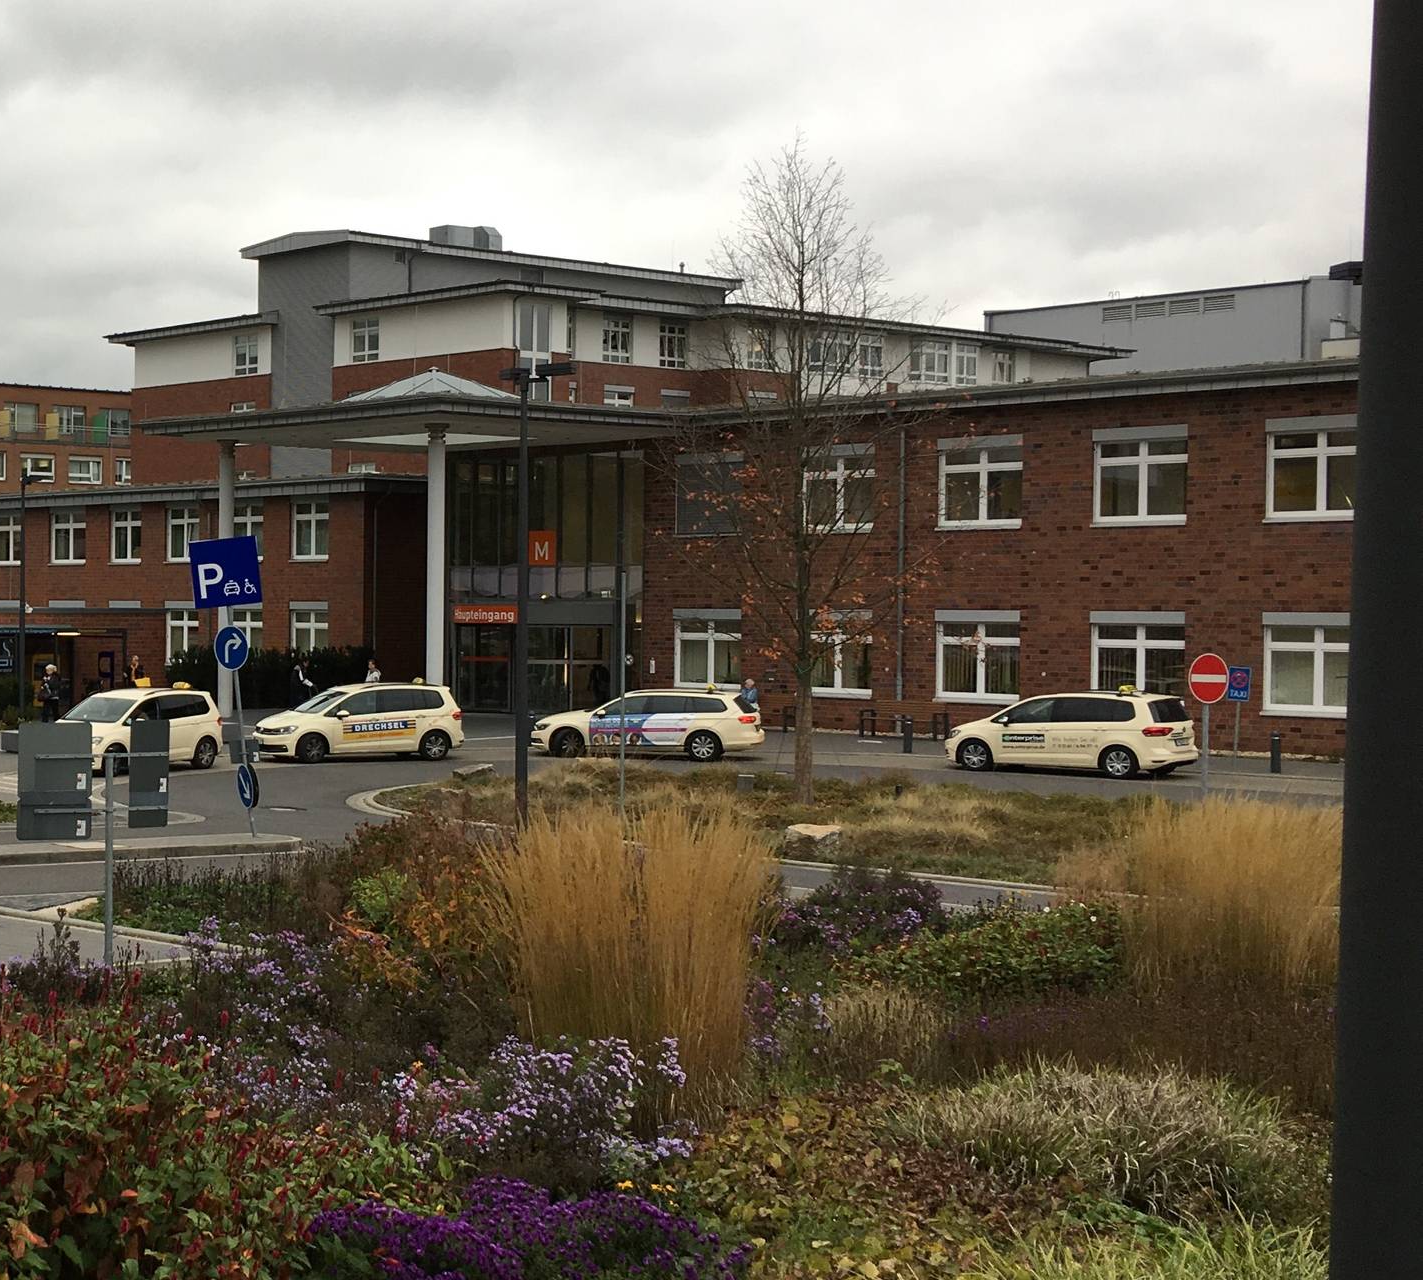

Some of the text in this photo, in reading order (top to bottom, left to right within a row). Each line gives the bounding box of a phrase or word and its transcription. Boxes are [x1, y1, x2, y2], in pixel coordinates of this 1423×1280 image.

[534, 541, 549, 561] M
[197, 563, 224, 600] P
[454, 608, 515, 623] Haupteingang
[1229, 689, 1248, 698] TAXI
[354, 721, 406, 732] DRECHSEL
